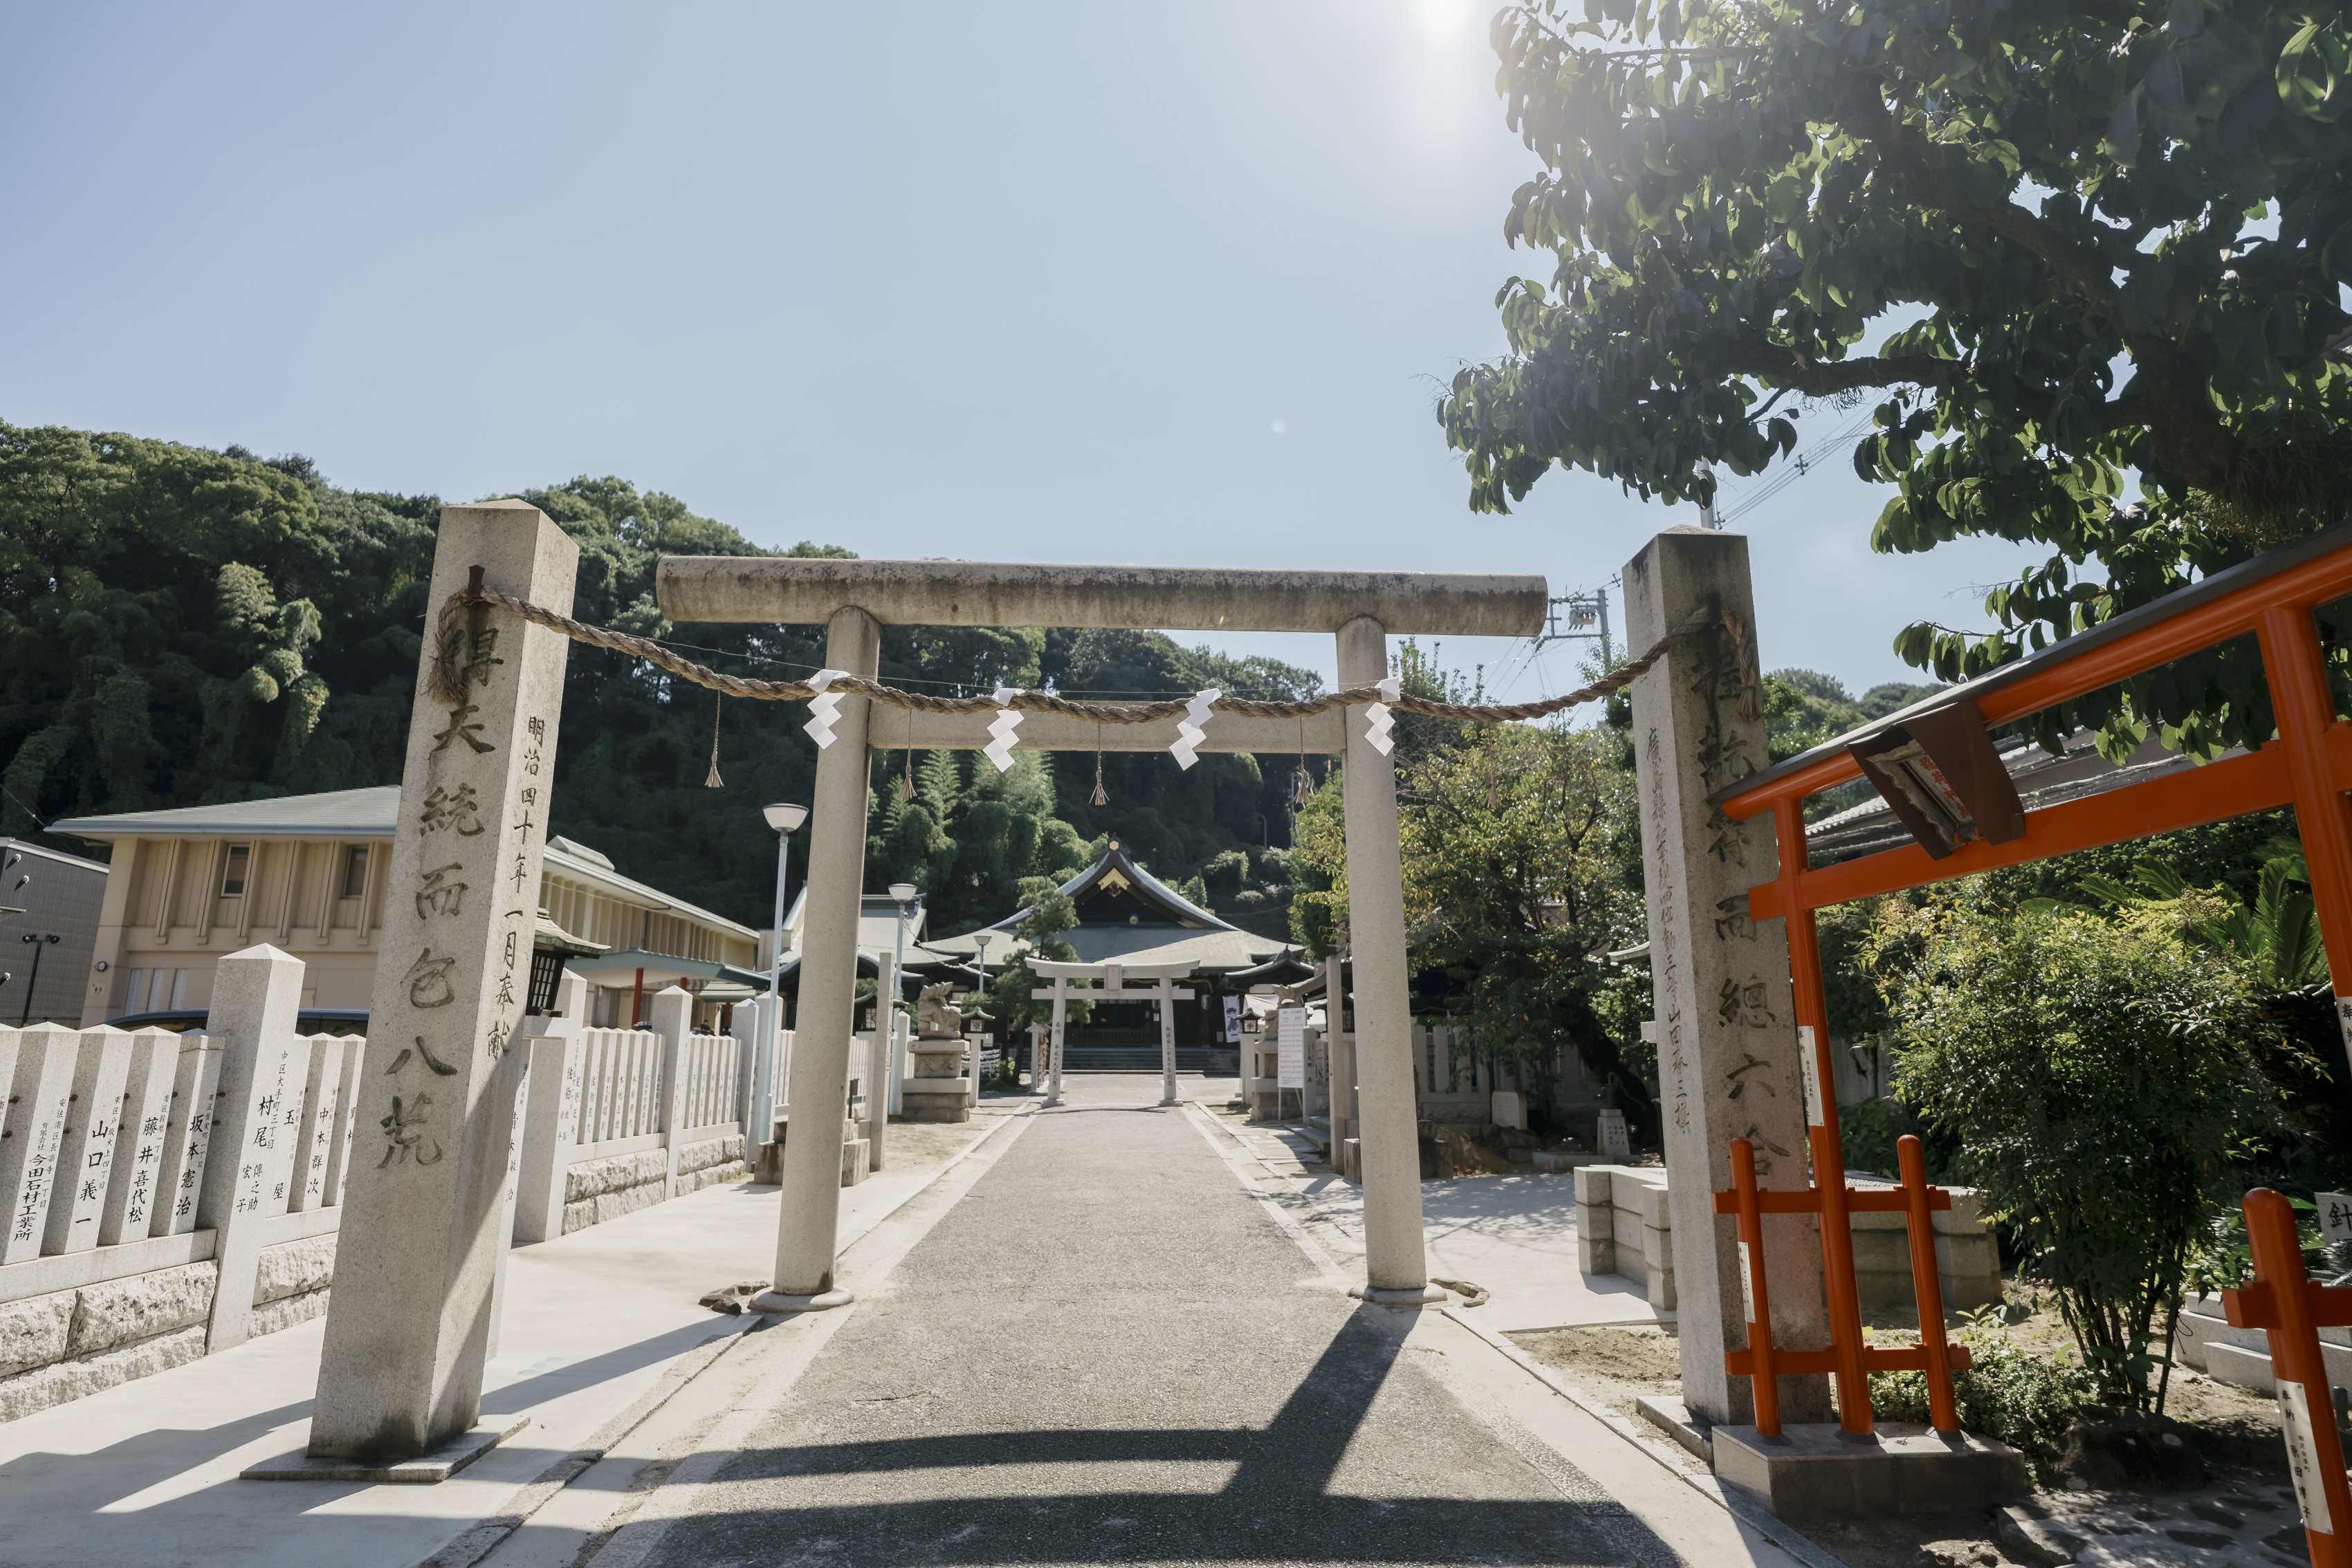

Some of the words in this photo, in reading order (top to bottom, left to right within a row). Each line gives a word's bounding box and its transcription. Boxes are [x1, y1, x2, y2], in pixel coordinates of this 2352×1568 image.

[99, 1096, 121, 1189] 東区戸坂大上四丁目
[197, 1094, 214, 1168] 南区皆実町一丁目
[252, 1095, 275, 1147] 村尾
[267, 1051, 288, 1150] 中区大手町三丁目
[39, 1098, 66, 1208] 安佐南区長楽寺一丁目
[75, 1120, 109, 1224] 山口義一
[128, 1116, 158, 1224] 藤井喜代松
[176, 1114, 204, 1217] 坂本憲治
[273, 1109, 295, 1200] 玉屋
[307, 1107, 329, 1195] 中本群次
[2281, 1389, 2295, 1421] 奉納
[2290, 1445, 2312, 1518] 原田博子
[2297, 1435, 2310, 1473] 南区金屋町
